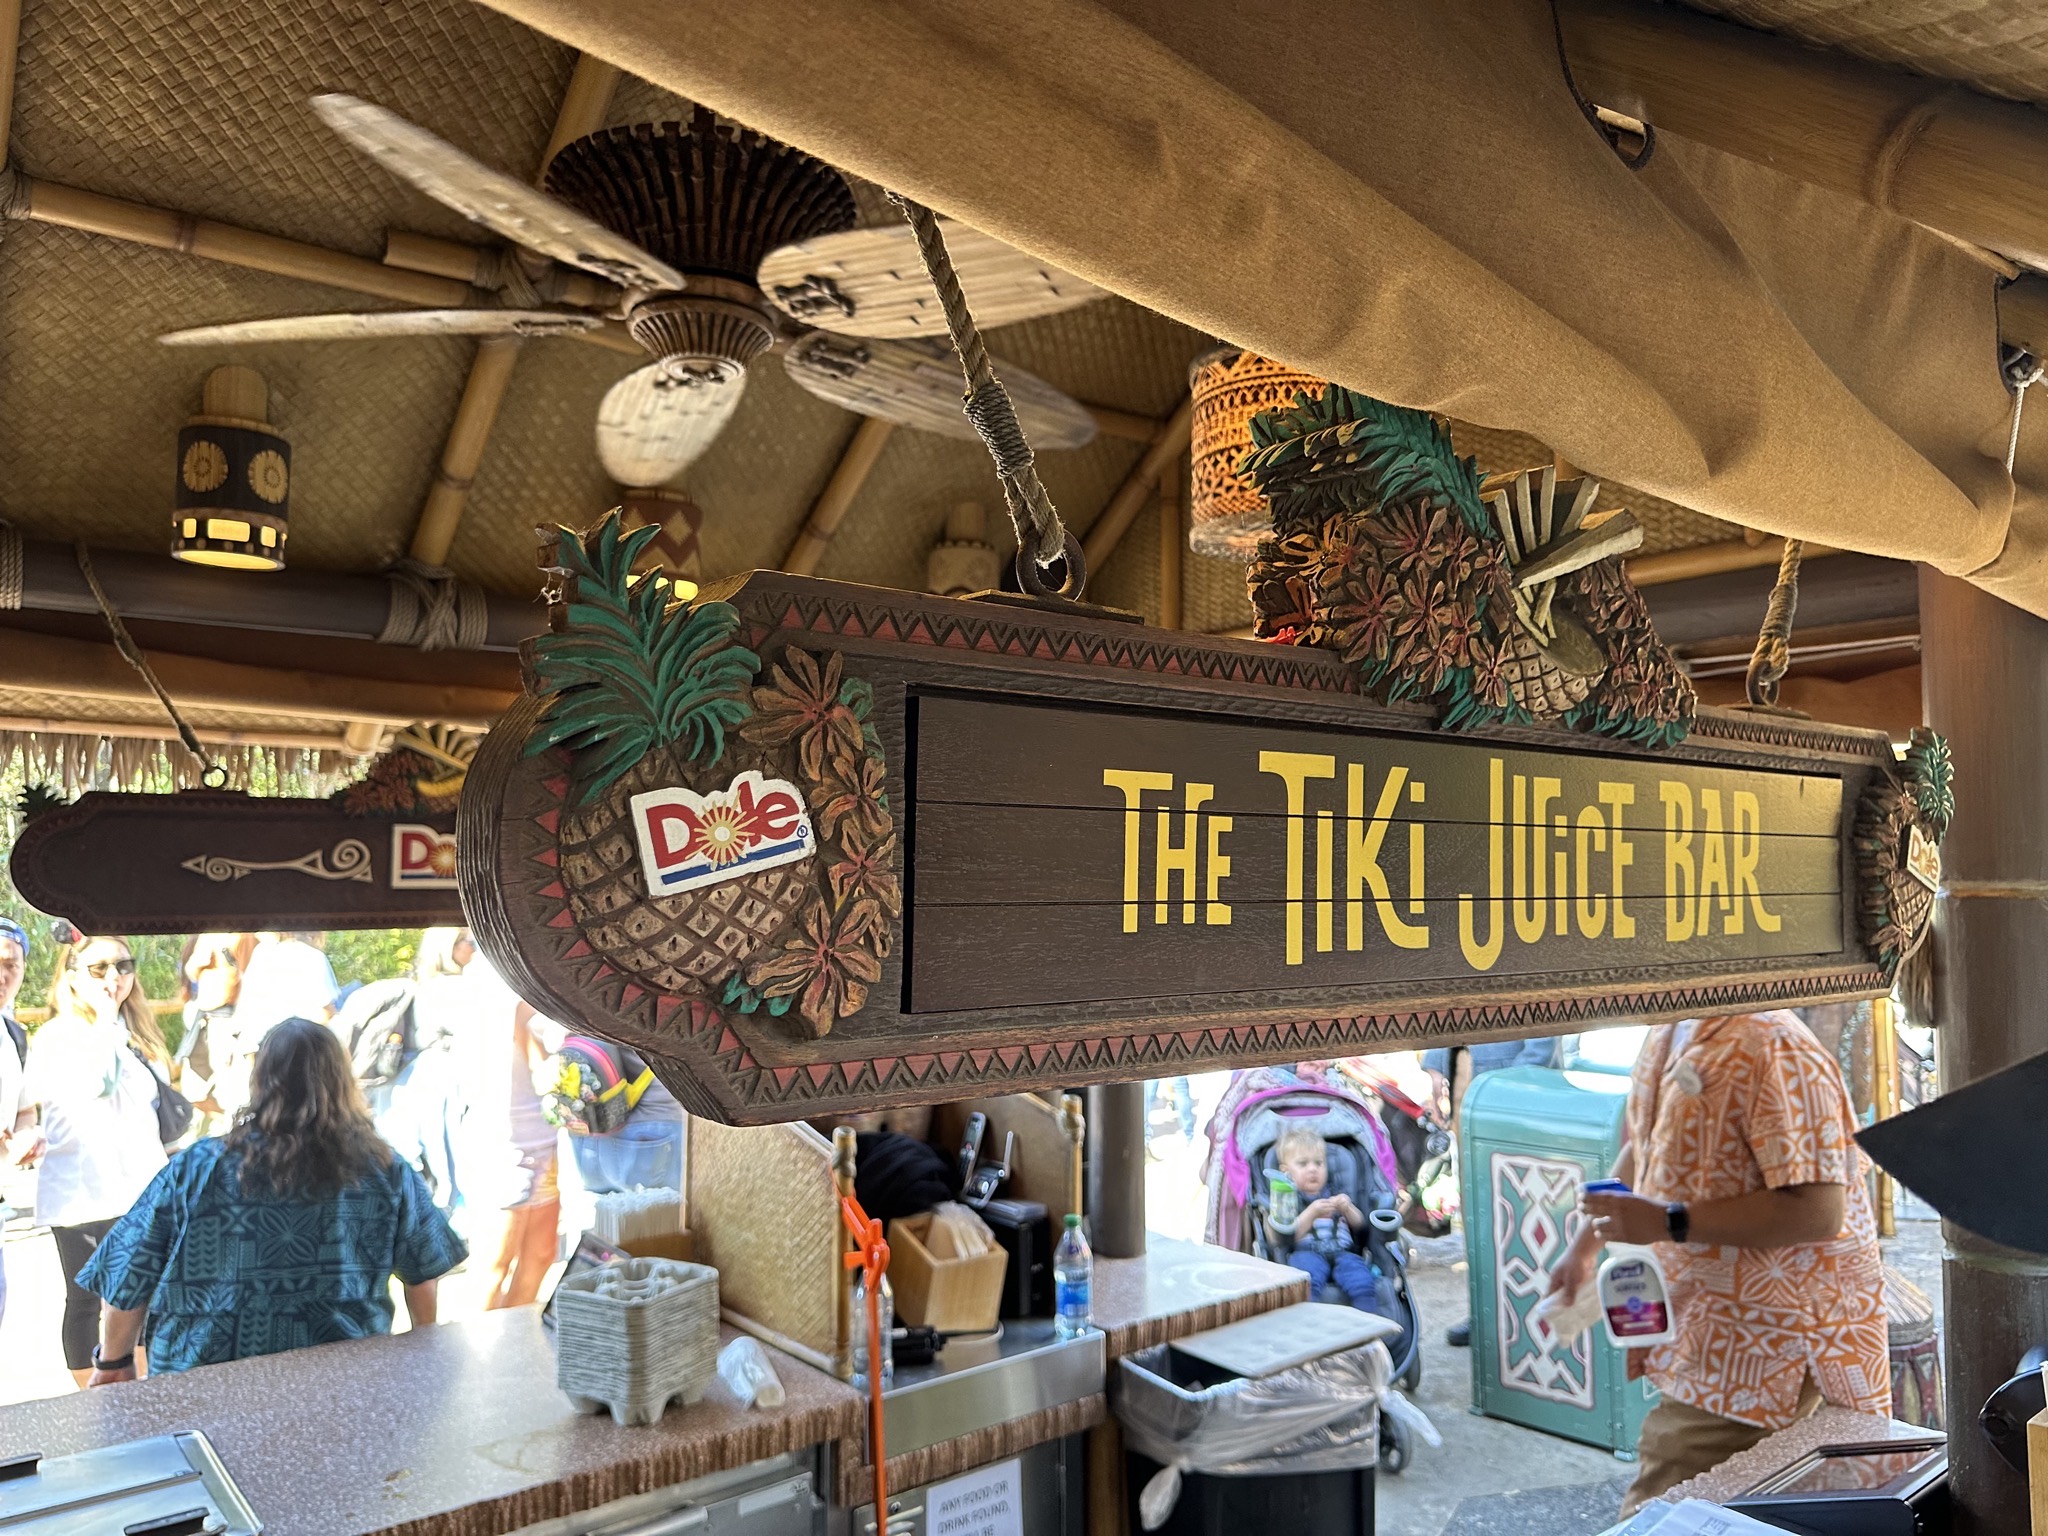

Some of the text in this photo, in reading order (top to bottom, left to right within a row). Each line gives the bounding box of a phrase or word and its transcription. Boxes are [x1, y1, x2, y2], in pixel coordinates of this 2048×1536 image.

[401, 832, 457, 878] Do
[645, 780, 801, 870] Dole
[1103, 768, 1233, 933] THE
[1659, 780, 1782, 942] BAR
